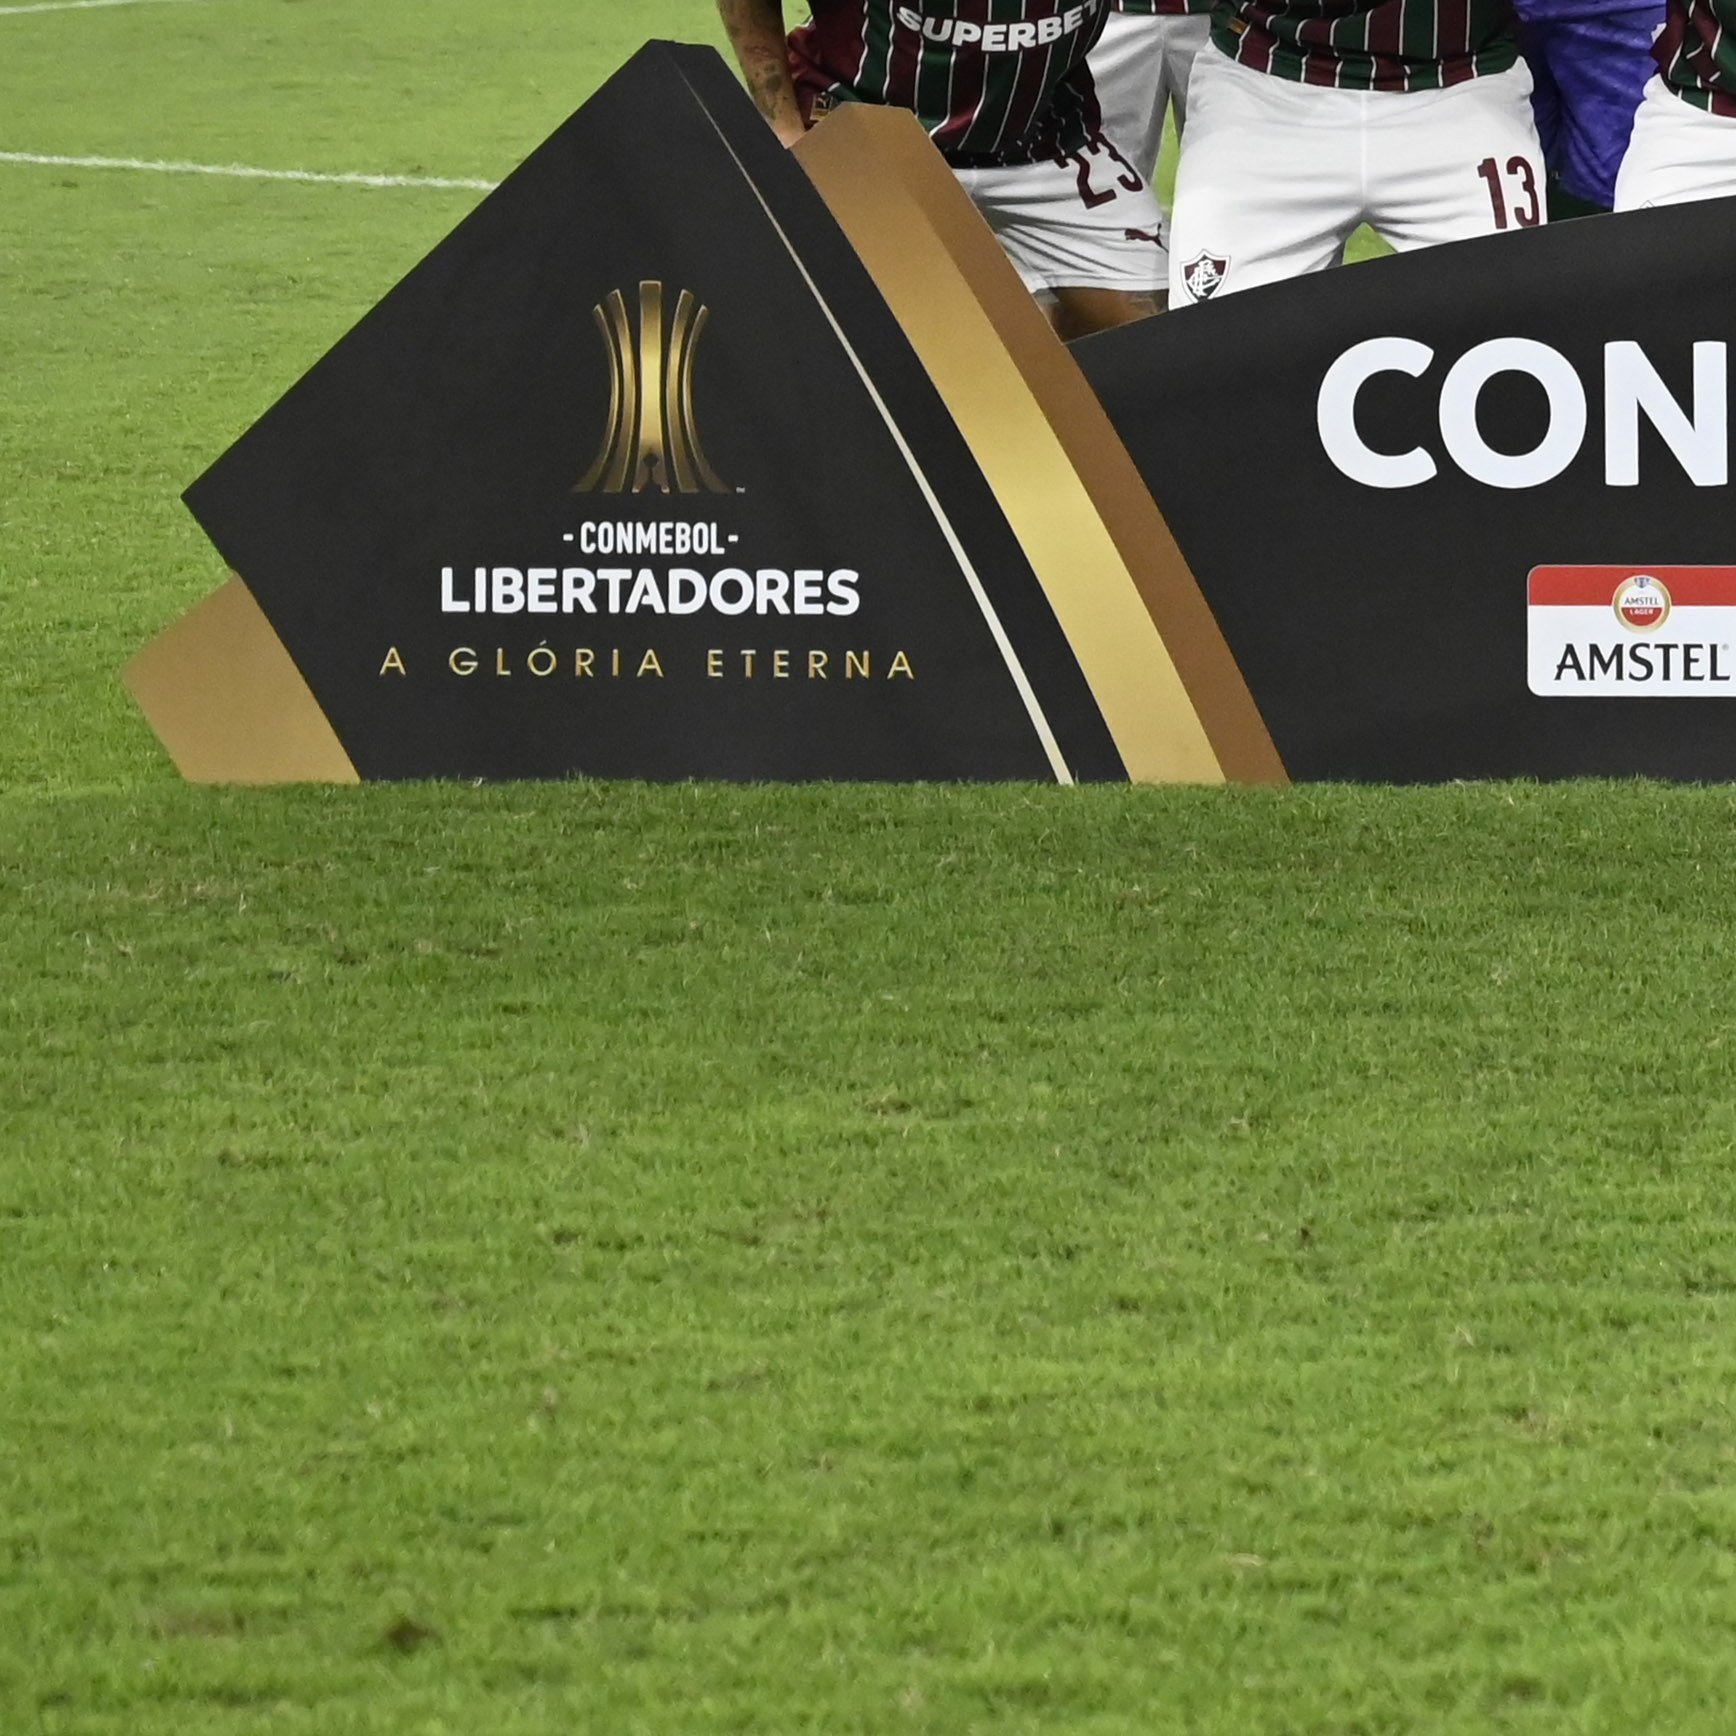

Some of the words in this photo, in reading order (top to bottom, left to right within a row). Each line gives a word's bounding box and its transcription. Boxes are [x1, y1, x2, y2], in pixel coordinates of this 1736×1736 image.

[1477, 156, 1540, 229] 13
[440, 566, 861, 617] LIBERTADORES
[1624, 597, 1659, 606] AMSTEL
[381, 648, 406, 676] A
[448, 639, 665, 679] GLÓRIA
[706, 649, 916, 680] ETERNA
[1554, 642, 1731, 682] AMSTEL
